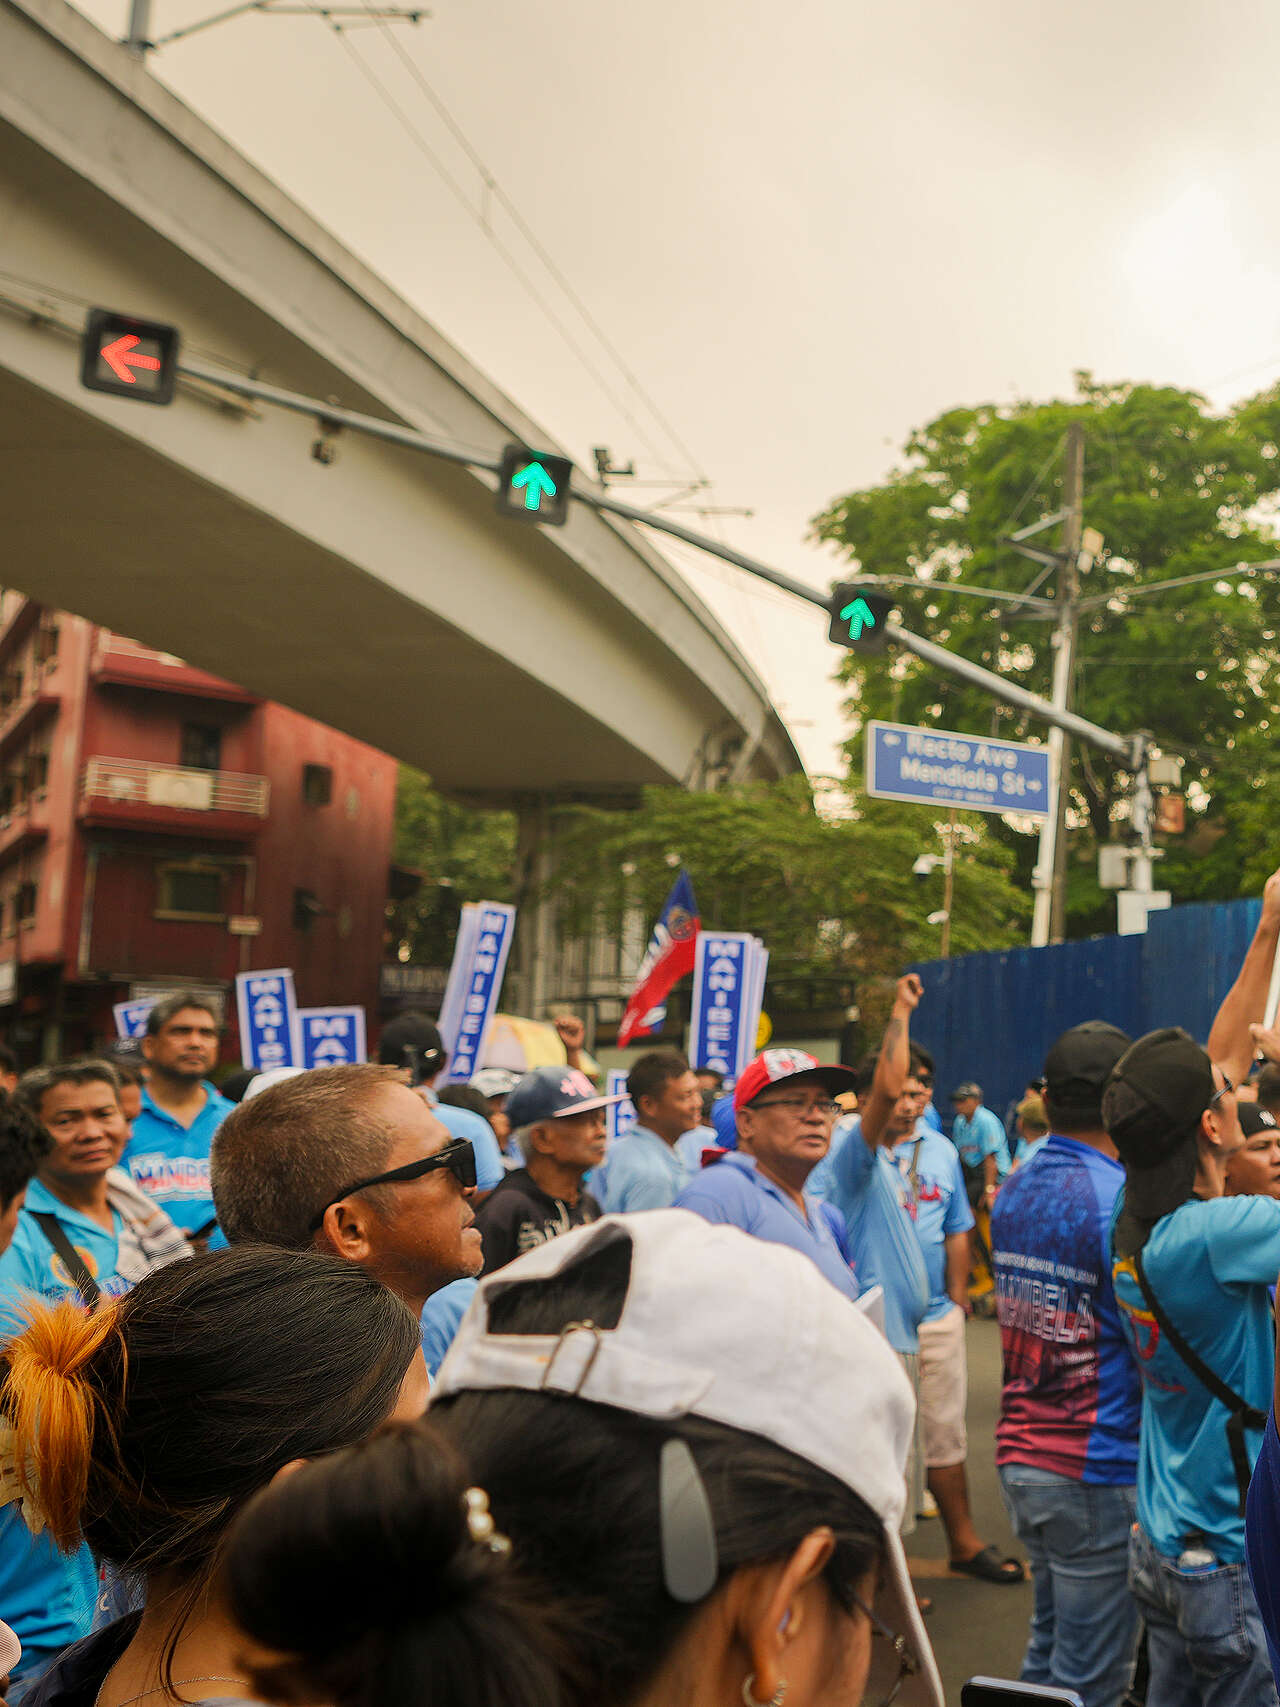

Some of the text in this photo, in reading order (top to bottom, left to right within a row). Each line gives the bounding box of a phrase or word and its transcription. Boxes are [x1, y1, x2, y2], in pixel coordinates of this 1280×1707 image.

[906, 733, 1018, 769] Recto Ave
[900, 756, 998, 792] Mendiola
[1002, 771, 1025, 797] St
[451, 912, 505, 1076] MANIBELA
